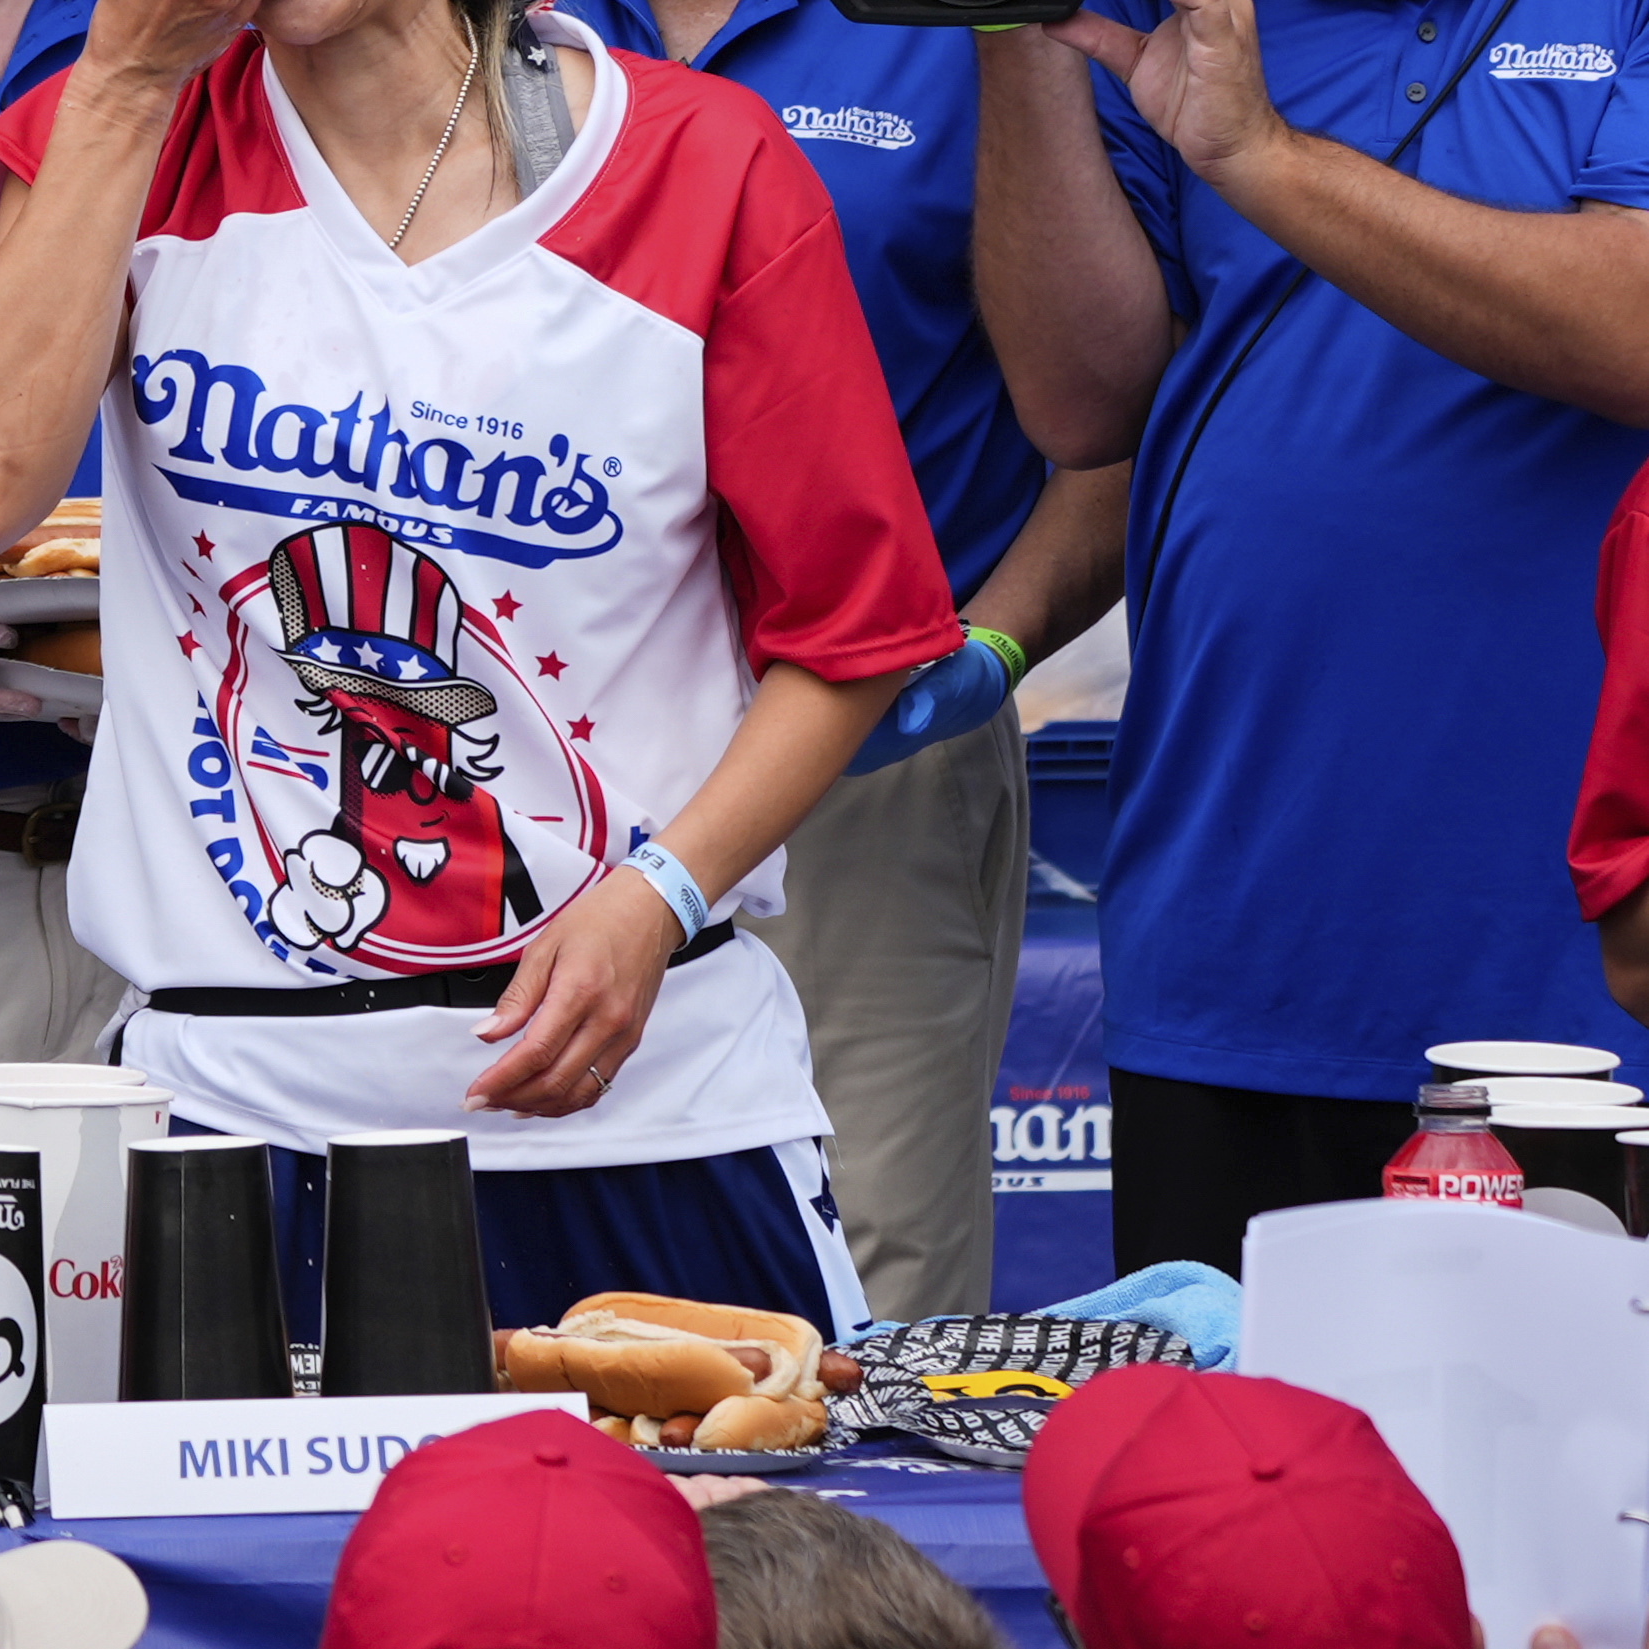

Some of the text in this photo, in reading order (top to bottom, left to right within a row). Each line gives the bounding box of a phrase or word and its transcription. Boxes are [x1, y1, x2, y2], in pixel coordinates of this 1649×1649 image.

[1488, 42, 1618, 73] Nathan's
[781, 104, 916, 143] Nathan's
[410, 400, 525, 441] Since 1916
[131, 349, 624, 558] Nathan's
[289, 497, 454, 546] FAMOUS
[628, 848, 667, 871] EAT
[1009, 1085, 1053, 1102] Since
[1438, 1174, 1525, 1201] POWER
[49, 1257, 124, 1301] Cok
[975, 1323, 1004, 1353] THE
[1012, 1324, 1040, 1353] THE
[1047, 1322, 1073, 1352] THE
[1080, 1322, 1108, 1346] THE
[178, 1437, 290, 1479] MIKI
